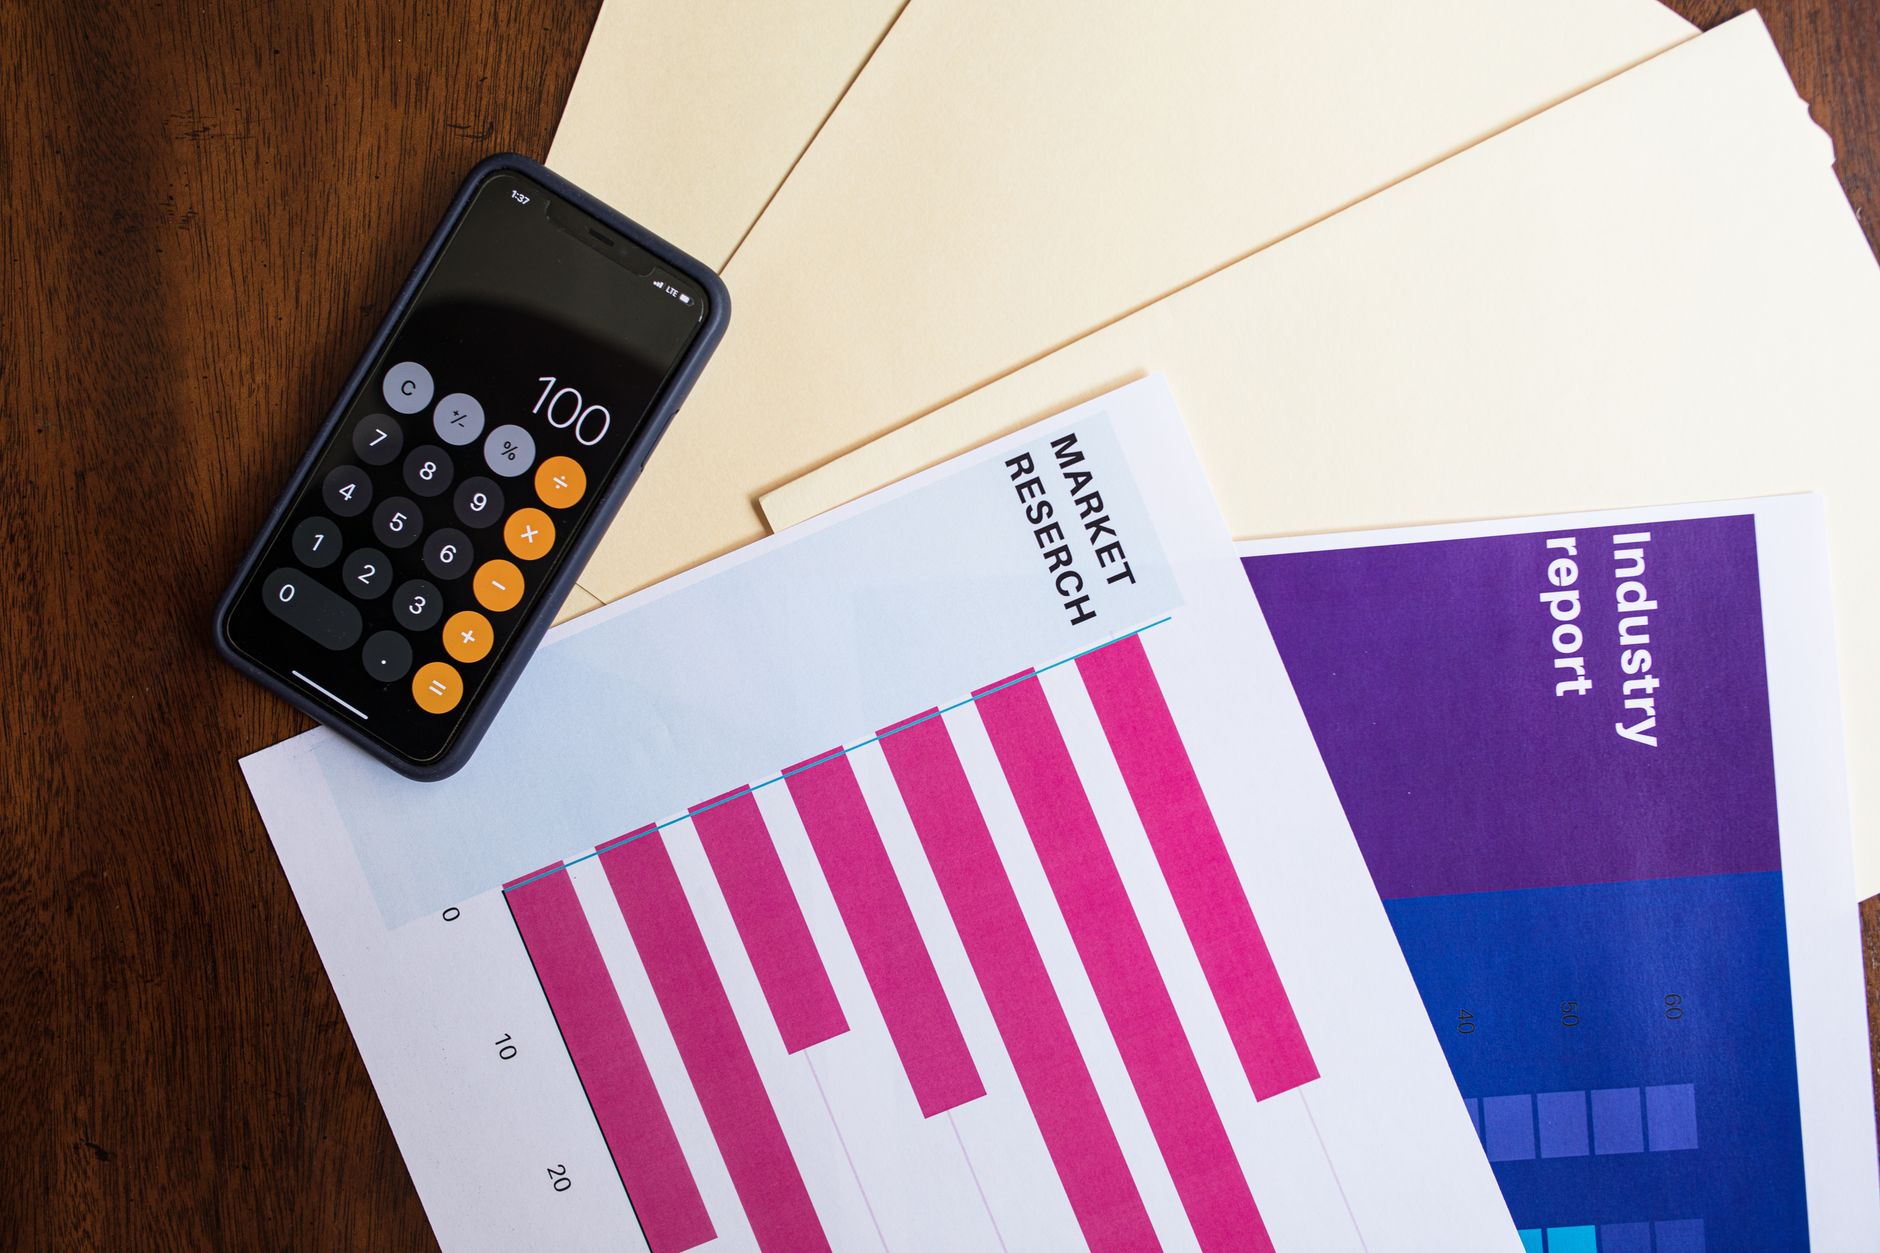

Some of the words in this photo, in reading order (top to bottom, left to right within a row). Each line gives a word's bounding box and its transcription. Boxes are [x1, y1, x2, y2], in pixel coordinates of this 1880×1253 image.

[511, 190, 529, 205] 1:37
[665, 284, 679, 297] LTE
[401, 380, 416, 396] C
[532, 376, 610, 445] 100
[369, 429, 387, 446] 7
[419, 462, 437, 481] 8
[470, 493, 487, 512] 9
[339, 483, 356, 501] 4
[389, 513, 407, 532] 5
[439, 544, 457, 564] 6
[1050, 432, 1136, 585] MARKET
[1004, 452, 1097, 626] RESERCH
[279, 584, 295, 602] 0
[312, 534, 325, 552] 1
[357, 565, 376, 584] 2
[409, 596, 426, 615] 3
[1540, 536, 1592, 696] report
[1612, 532, 1660, 748] Industry
[442, 907, 460, 922] 0
[1457, 1008, 1476, 1034] 40
[1559, 1000, 1580, 1028] 50
[1664, 993, 1683, 1020] 60
[495, 1033, 517, 1060] 10
[546, 1164, 572, 1192] 20
